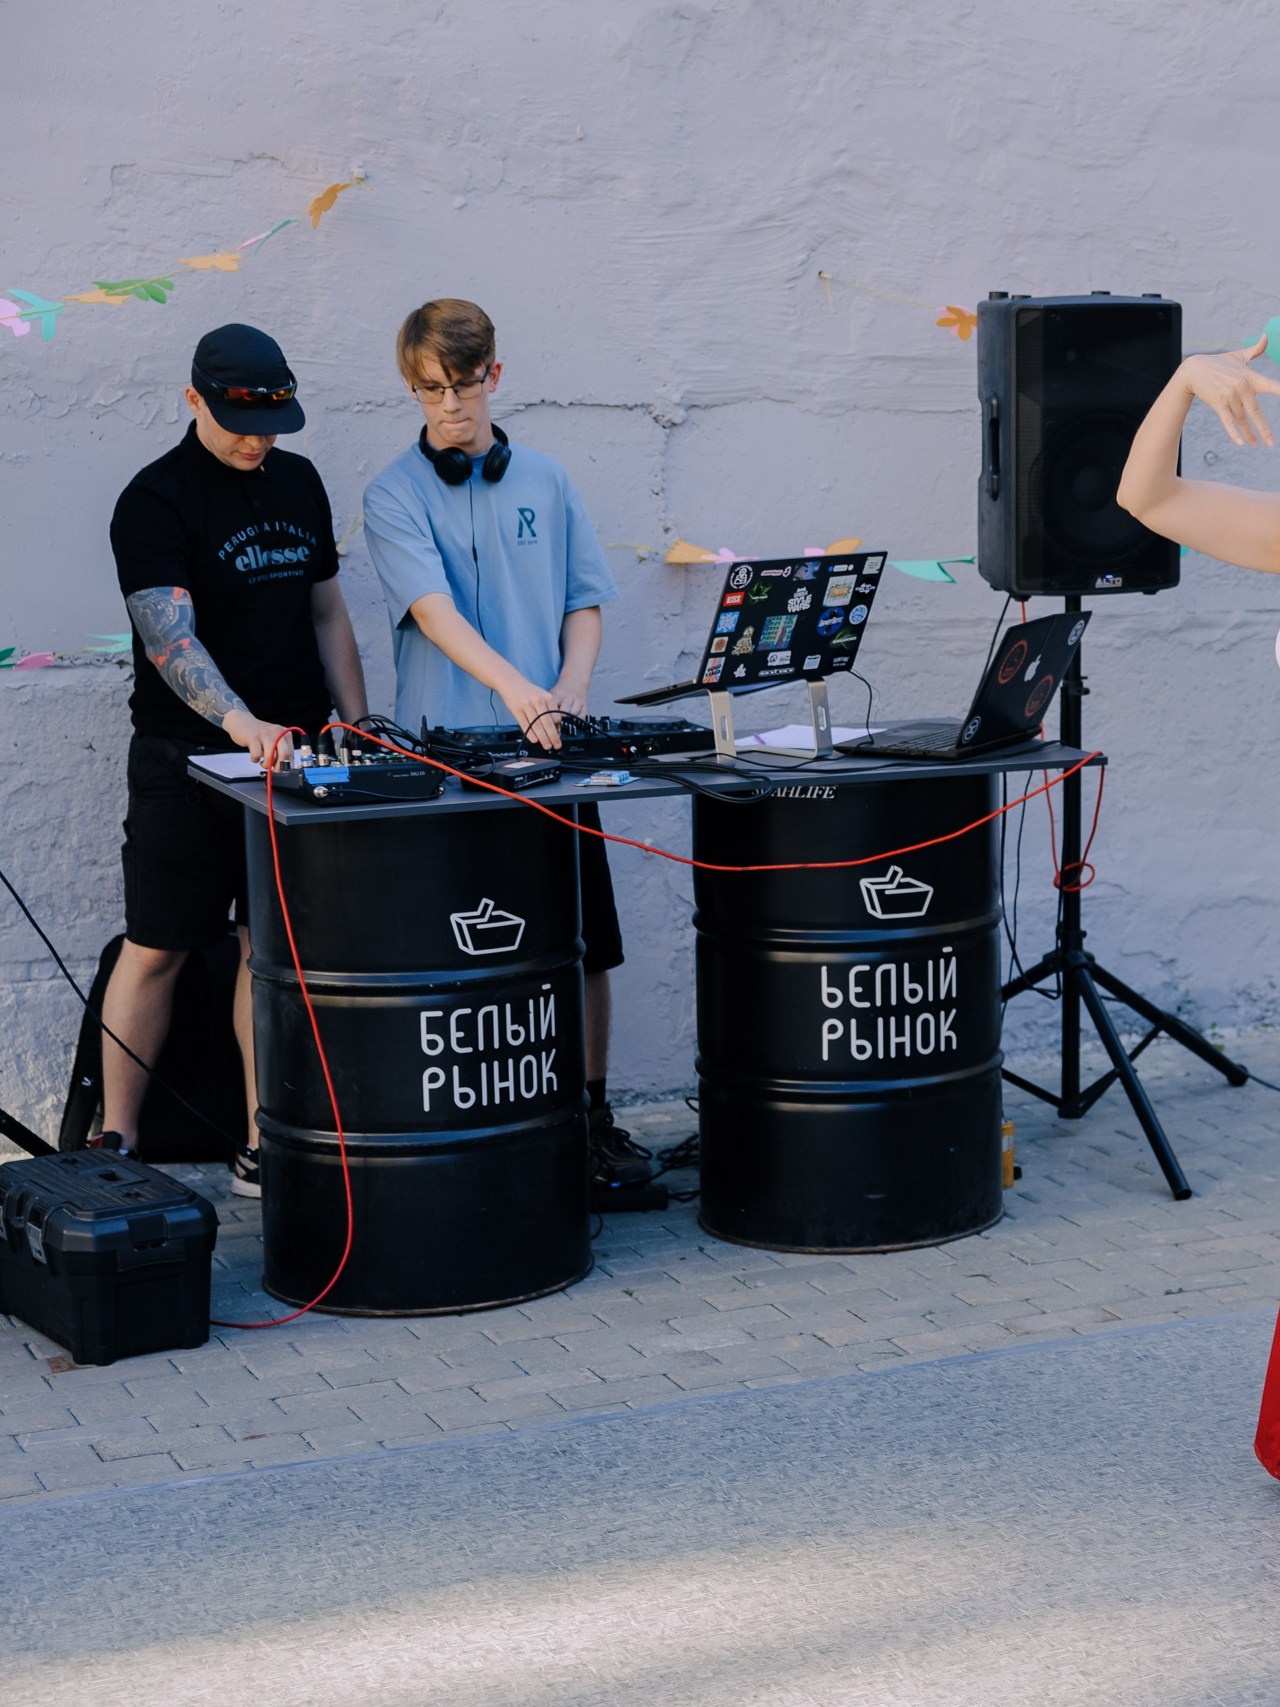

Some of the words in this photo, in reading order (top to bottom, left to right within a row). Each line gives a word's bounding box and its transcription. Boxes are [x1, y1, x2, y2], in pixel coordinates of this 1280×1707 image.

[218, 521, 271, 561] PERUGIA
[274, 521, 317, 546] ITALIA
[234, 544, 311, 572] ellesse
[1095, 576, 1123, 589] ALTO
[420, 983, 556, 1056] БЕЛЫЙ
[822, 1007, 957, 1061] РЫНОК
[422, 1048, 557, 1112] РЫНОК
